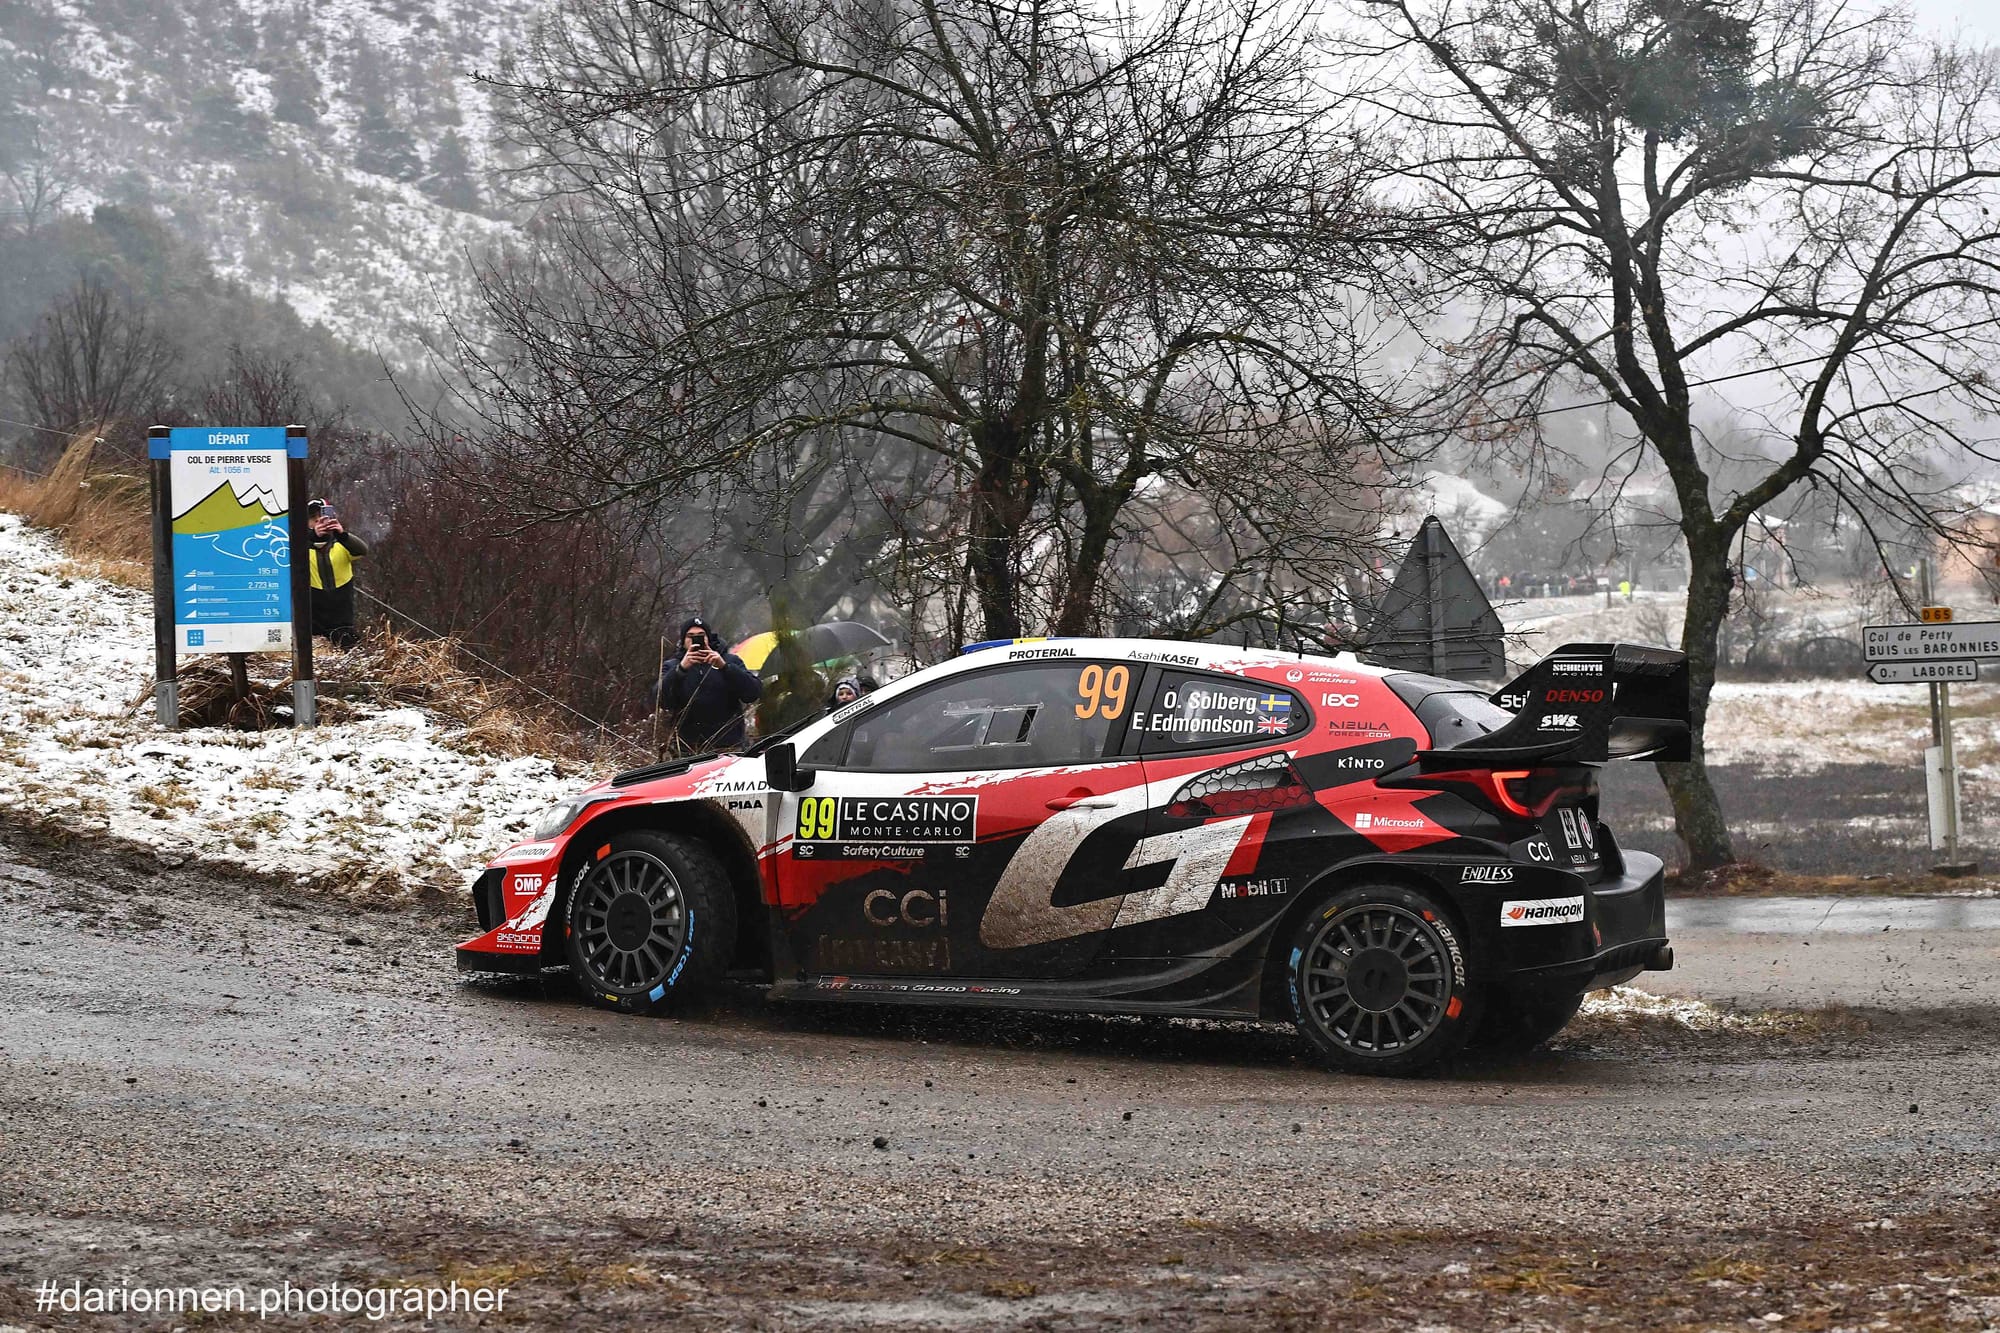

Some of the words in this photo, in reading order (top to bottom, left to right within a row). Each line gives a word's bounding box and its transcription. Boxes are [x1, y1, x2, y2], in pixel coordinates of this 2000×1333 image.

[208, 432, 250, 445] DÉPART
[187, 455, 203, 464] COL
[205, 455, 216, 464] DE
[217, 455, 245, 464] PIERRE
[246, 455, 272, 464] VESCE
[263, 608, 271, 616] 13
[272, 608, 280, 616] %
[1922, 609, 1930, 620] D
[1934, 609, 1951, 620] 65
[1868, 632, 1889, 642] Col
[1897, 631, 1912, 641] de
[1919, 630, 1953, 641] Perty
[1008, 647, 1077, 660] PROTERIAL
[1869, 645, 1898, 656] BUIS
[1924, 641, 1999, 654] BARONNIES
[1912, 665, 1973, 677] LABOREL
[1307, 677, 1358, 685] AIRLINES
[1075, 664, 1130, 720] 99
[1545, 689, 1604, 703] DENSO
[1188, 691, 1257, 714] Solberg
[728, 799, 763, 810] PIAA
[844, 802, 868, 821] LE
[873, 802, 970, 821] CASINO
[799, 796, 836, 840] 99
[1373, 816, 1425, 828] Microsoft
[799, 845, 815, 856] SC
[954, 846, 970, 856] SC
[1461, 866, 1514, 881] ENDLESS
[514, 877, 543, 892] OMP
[1220, 880, 1268, 899] Mobil
[911, 984, 967, 993] GAZOO
